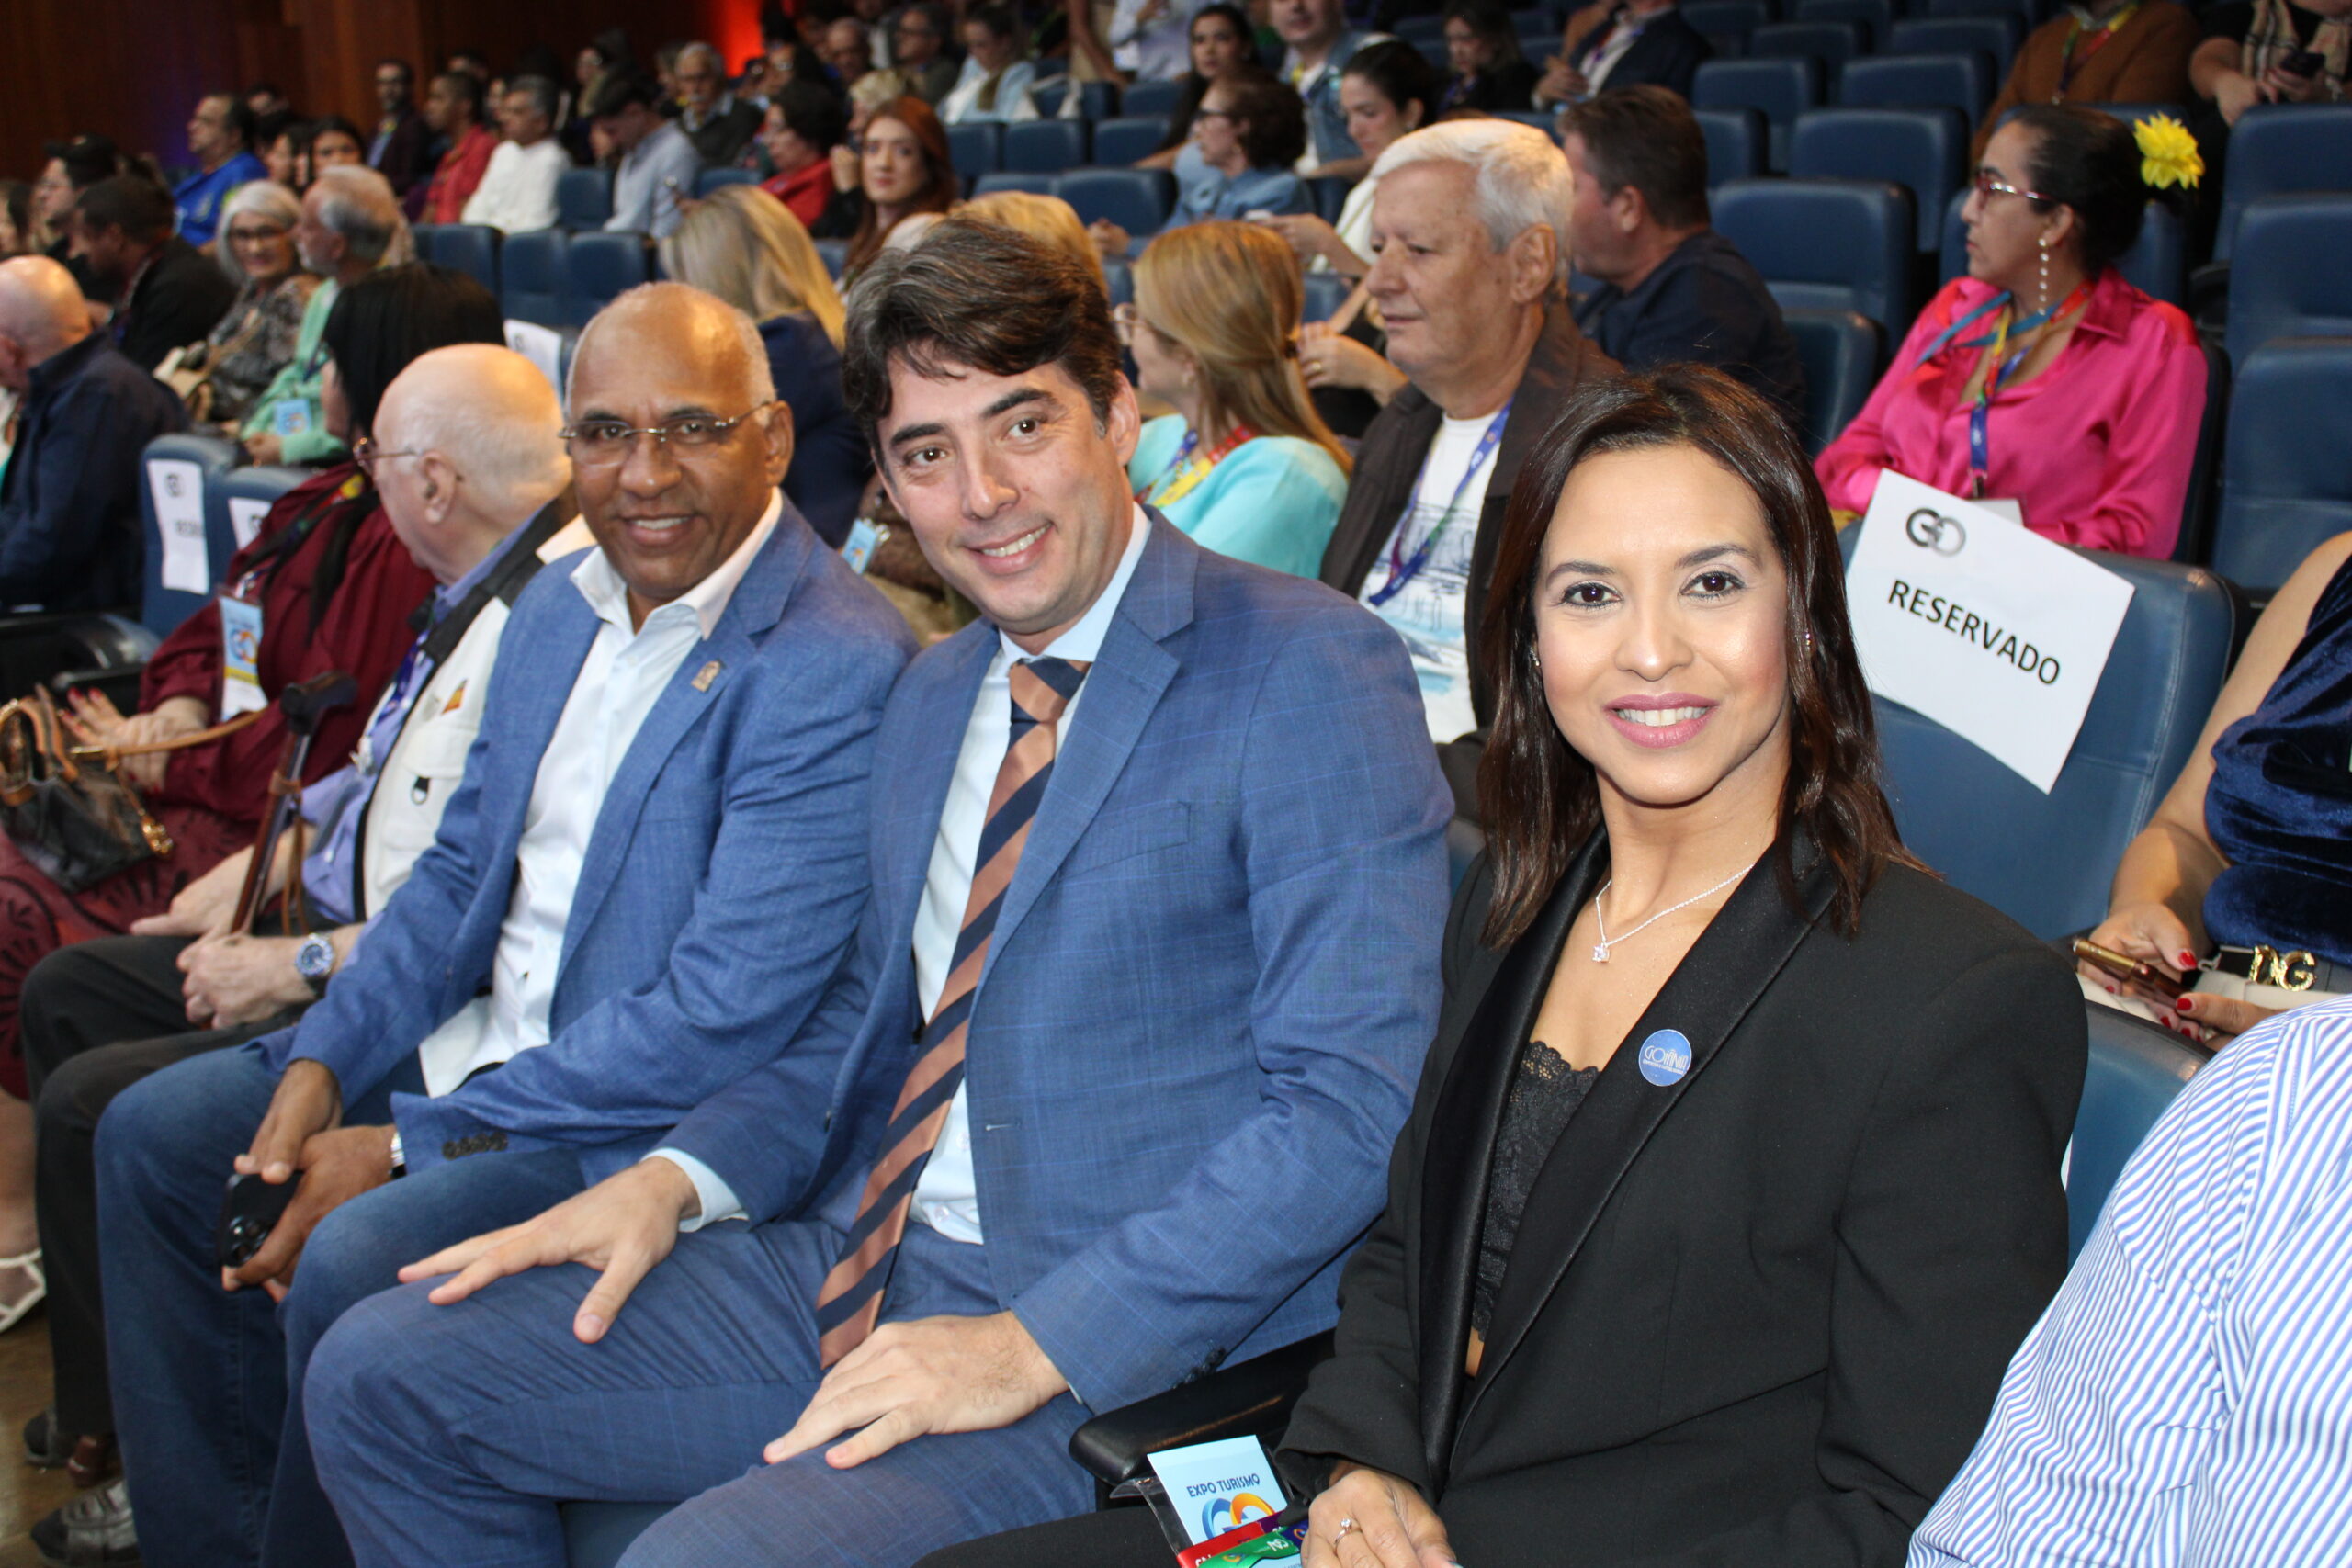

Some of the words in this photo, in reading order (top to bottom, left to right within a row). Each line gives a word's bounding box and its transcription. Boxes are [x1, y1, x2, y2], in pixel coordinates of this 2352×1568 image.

[1888, 580, 2060, 685] RESERVADO
[1186, 1482, 1216, 1497] EXPO
[1216, 1472, 1260, 1492] TURISMO
